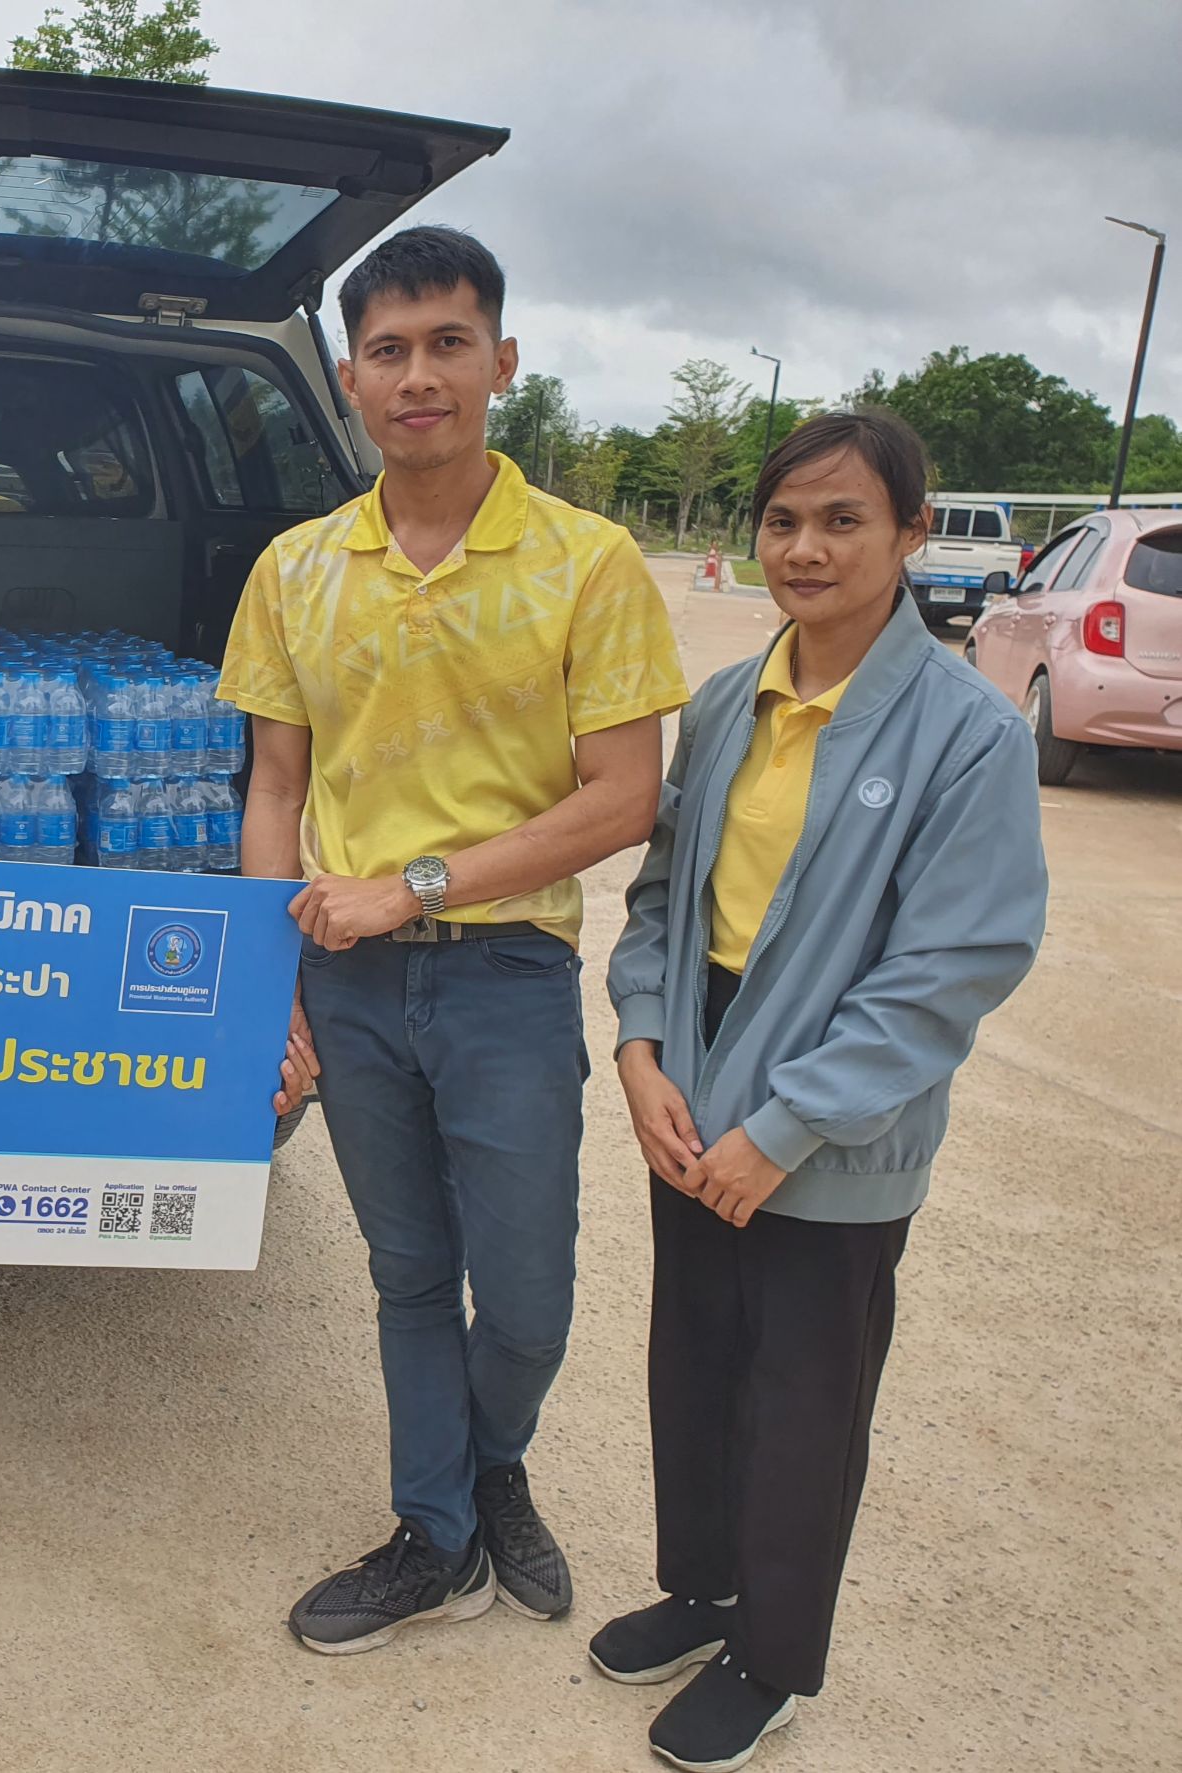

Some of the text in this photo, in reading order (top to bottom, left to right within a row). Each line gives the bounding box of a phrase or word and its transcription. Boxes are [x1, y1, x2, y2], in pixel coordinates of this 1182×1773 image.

[129, 984, 209, 995] การประปาส่วนภูมิภาค
[21, 1184, 57, 1193] Contact
[60, 1185, 91, 1194] Center
[104, 1182, 145, 1191] Application
[154, 1183, 198, 1192] Line Official
[21, 1196, 89, 1218] 1662
